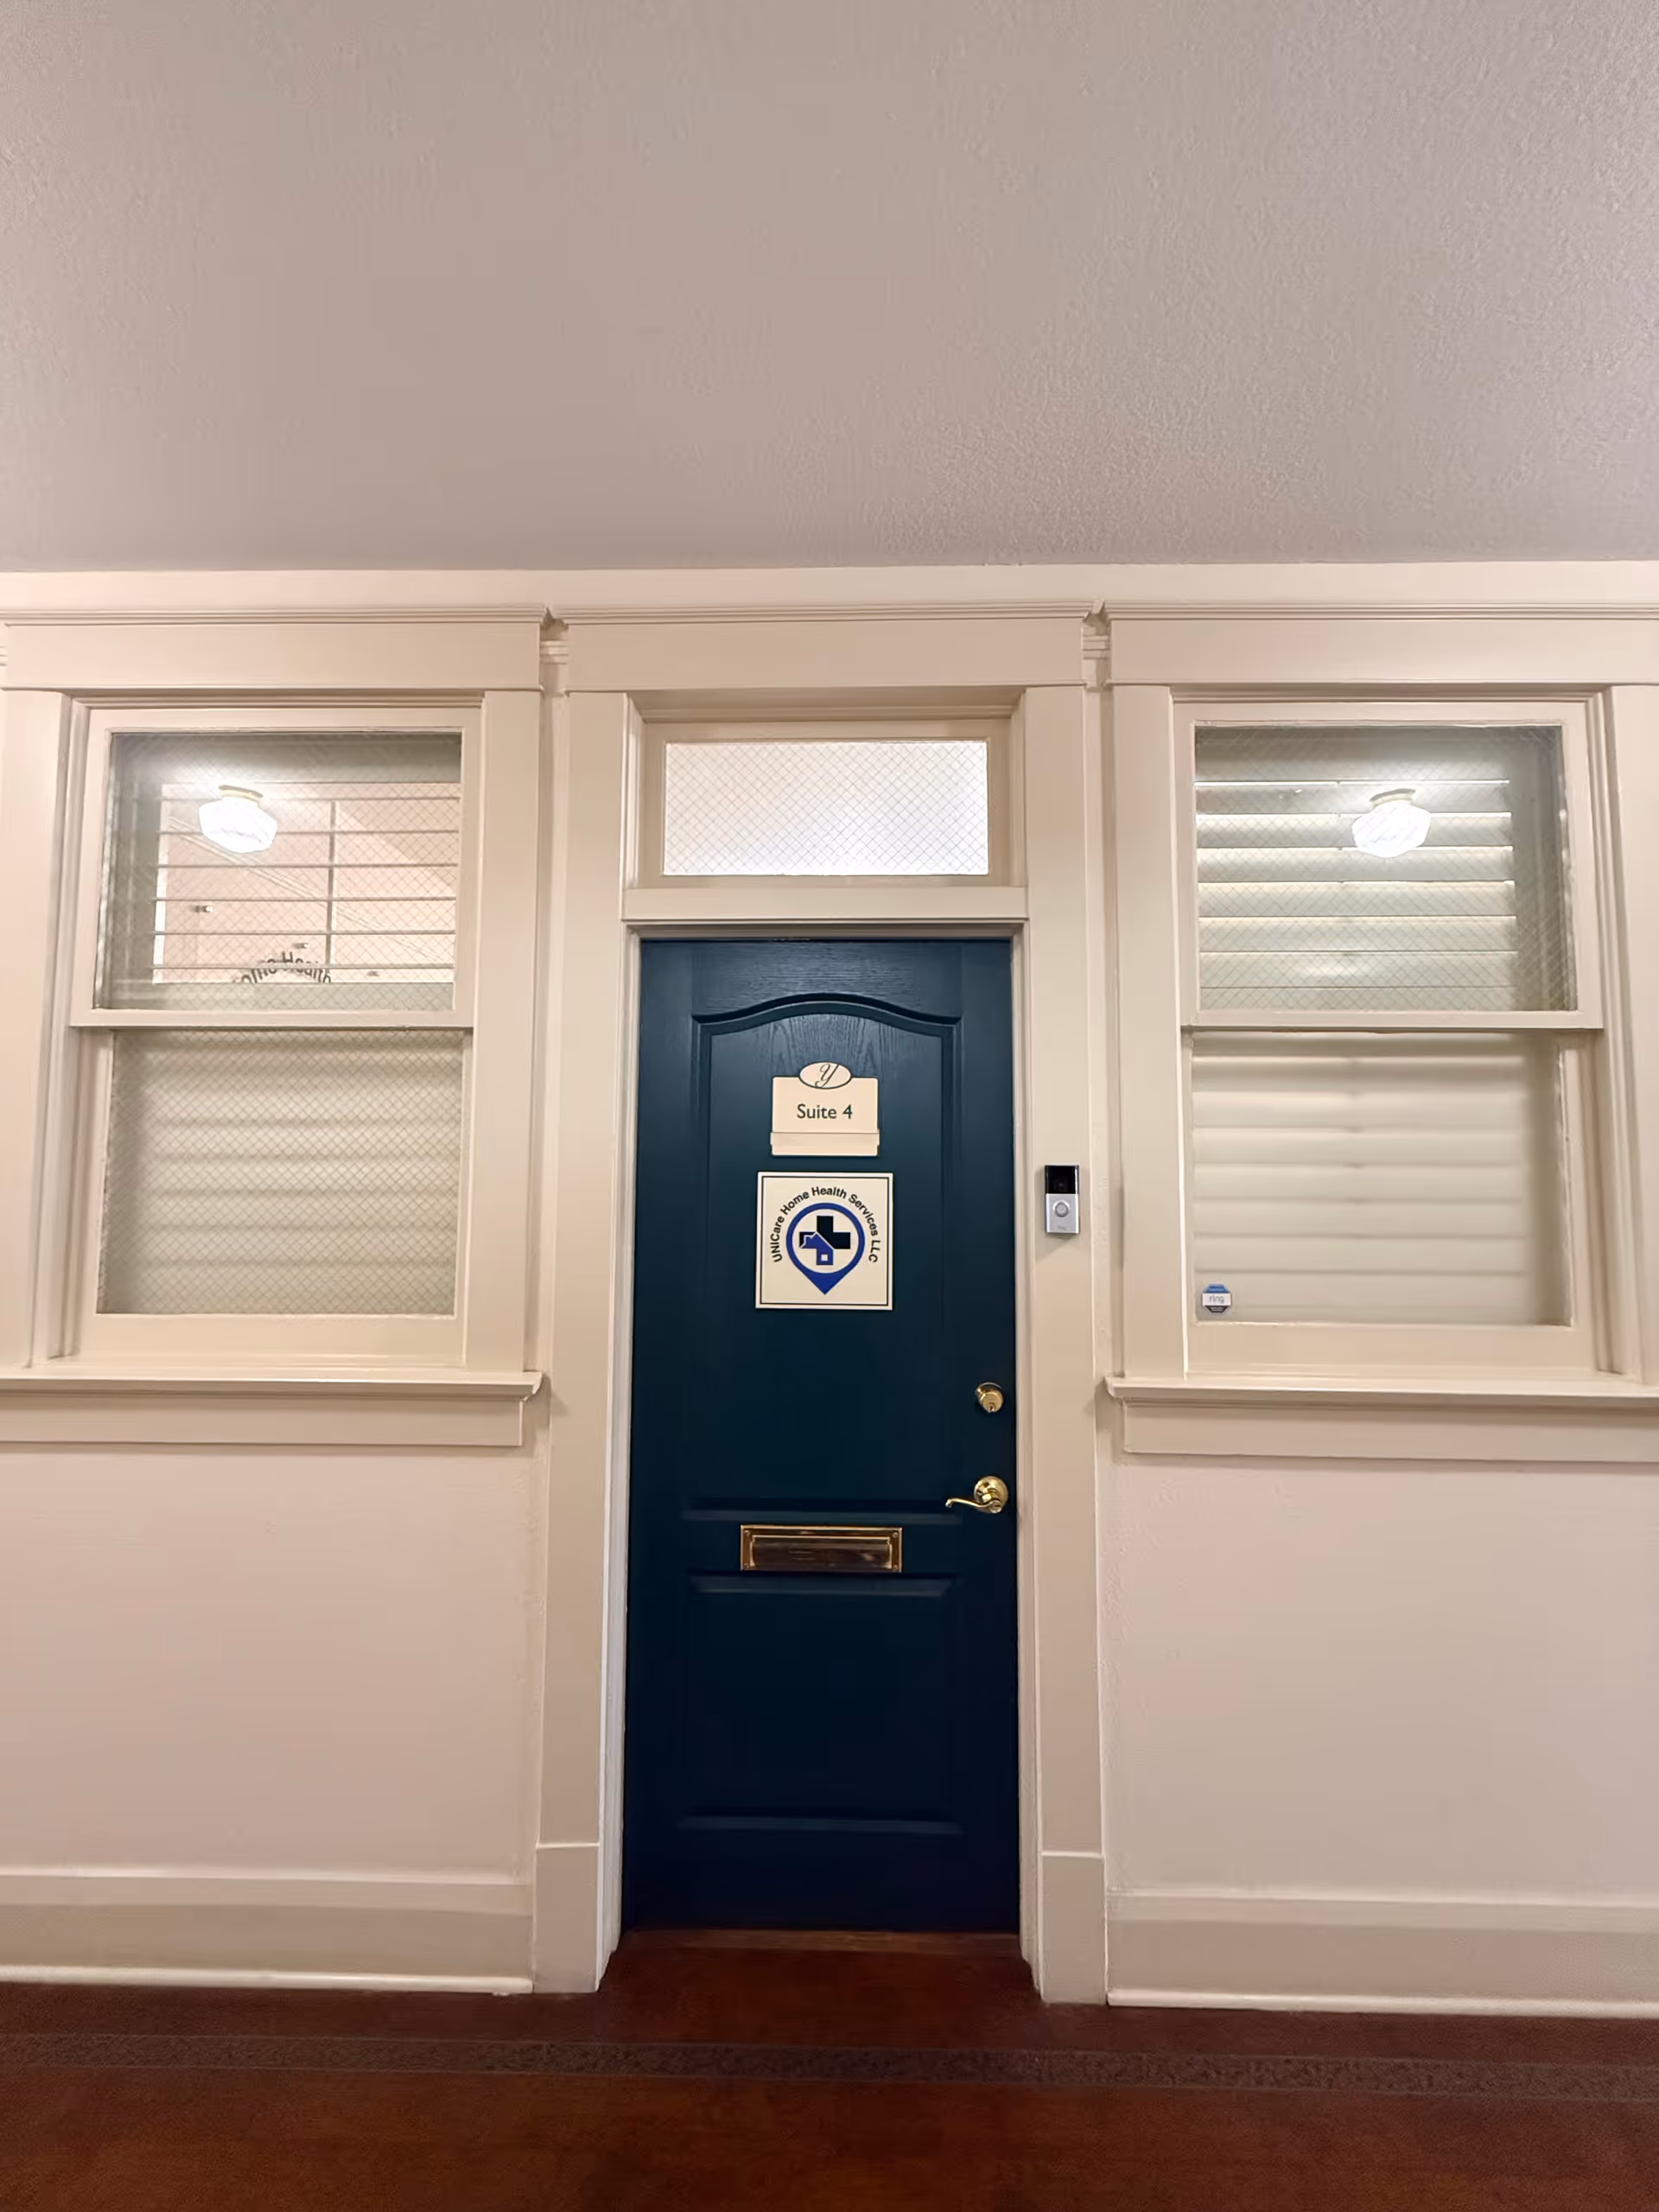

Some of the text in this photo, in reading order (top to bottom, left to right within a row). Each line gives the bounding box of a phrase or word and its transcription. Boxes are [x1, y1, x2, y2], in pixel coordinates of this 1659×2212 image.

[797, 1103, 853, 1119] Suite 4
[770, 1185, 881, 1263] UNICare Home Health Services LLC
[1209, 1294, 1225, 1304] ring
